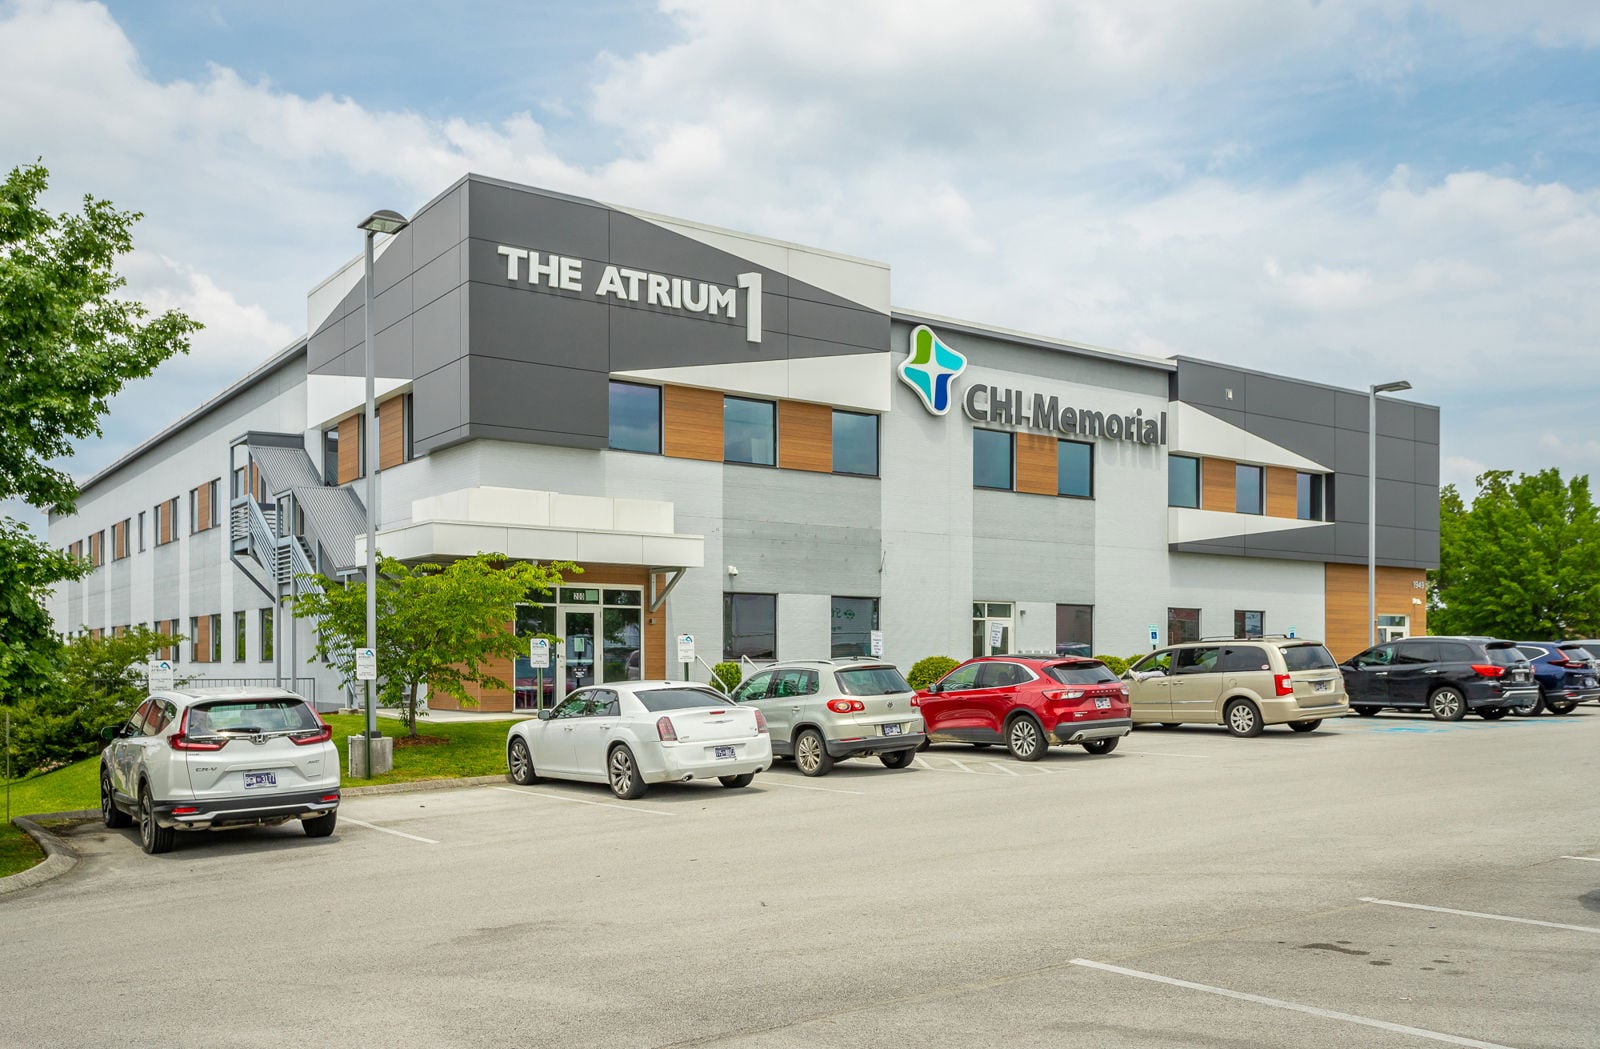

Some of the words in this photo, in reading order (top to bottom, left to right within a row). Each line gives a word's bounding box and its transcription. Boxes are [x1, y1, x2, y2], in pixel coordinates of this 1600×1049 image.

[497, 245, 583, 292] THE
[595, 265, 736, 319] ATRIUM
[963, 383, 1023, 427] CHI
[1030, 392, 1167, 446] Memorial
